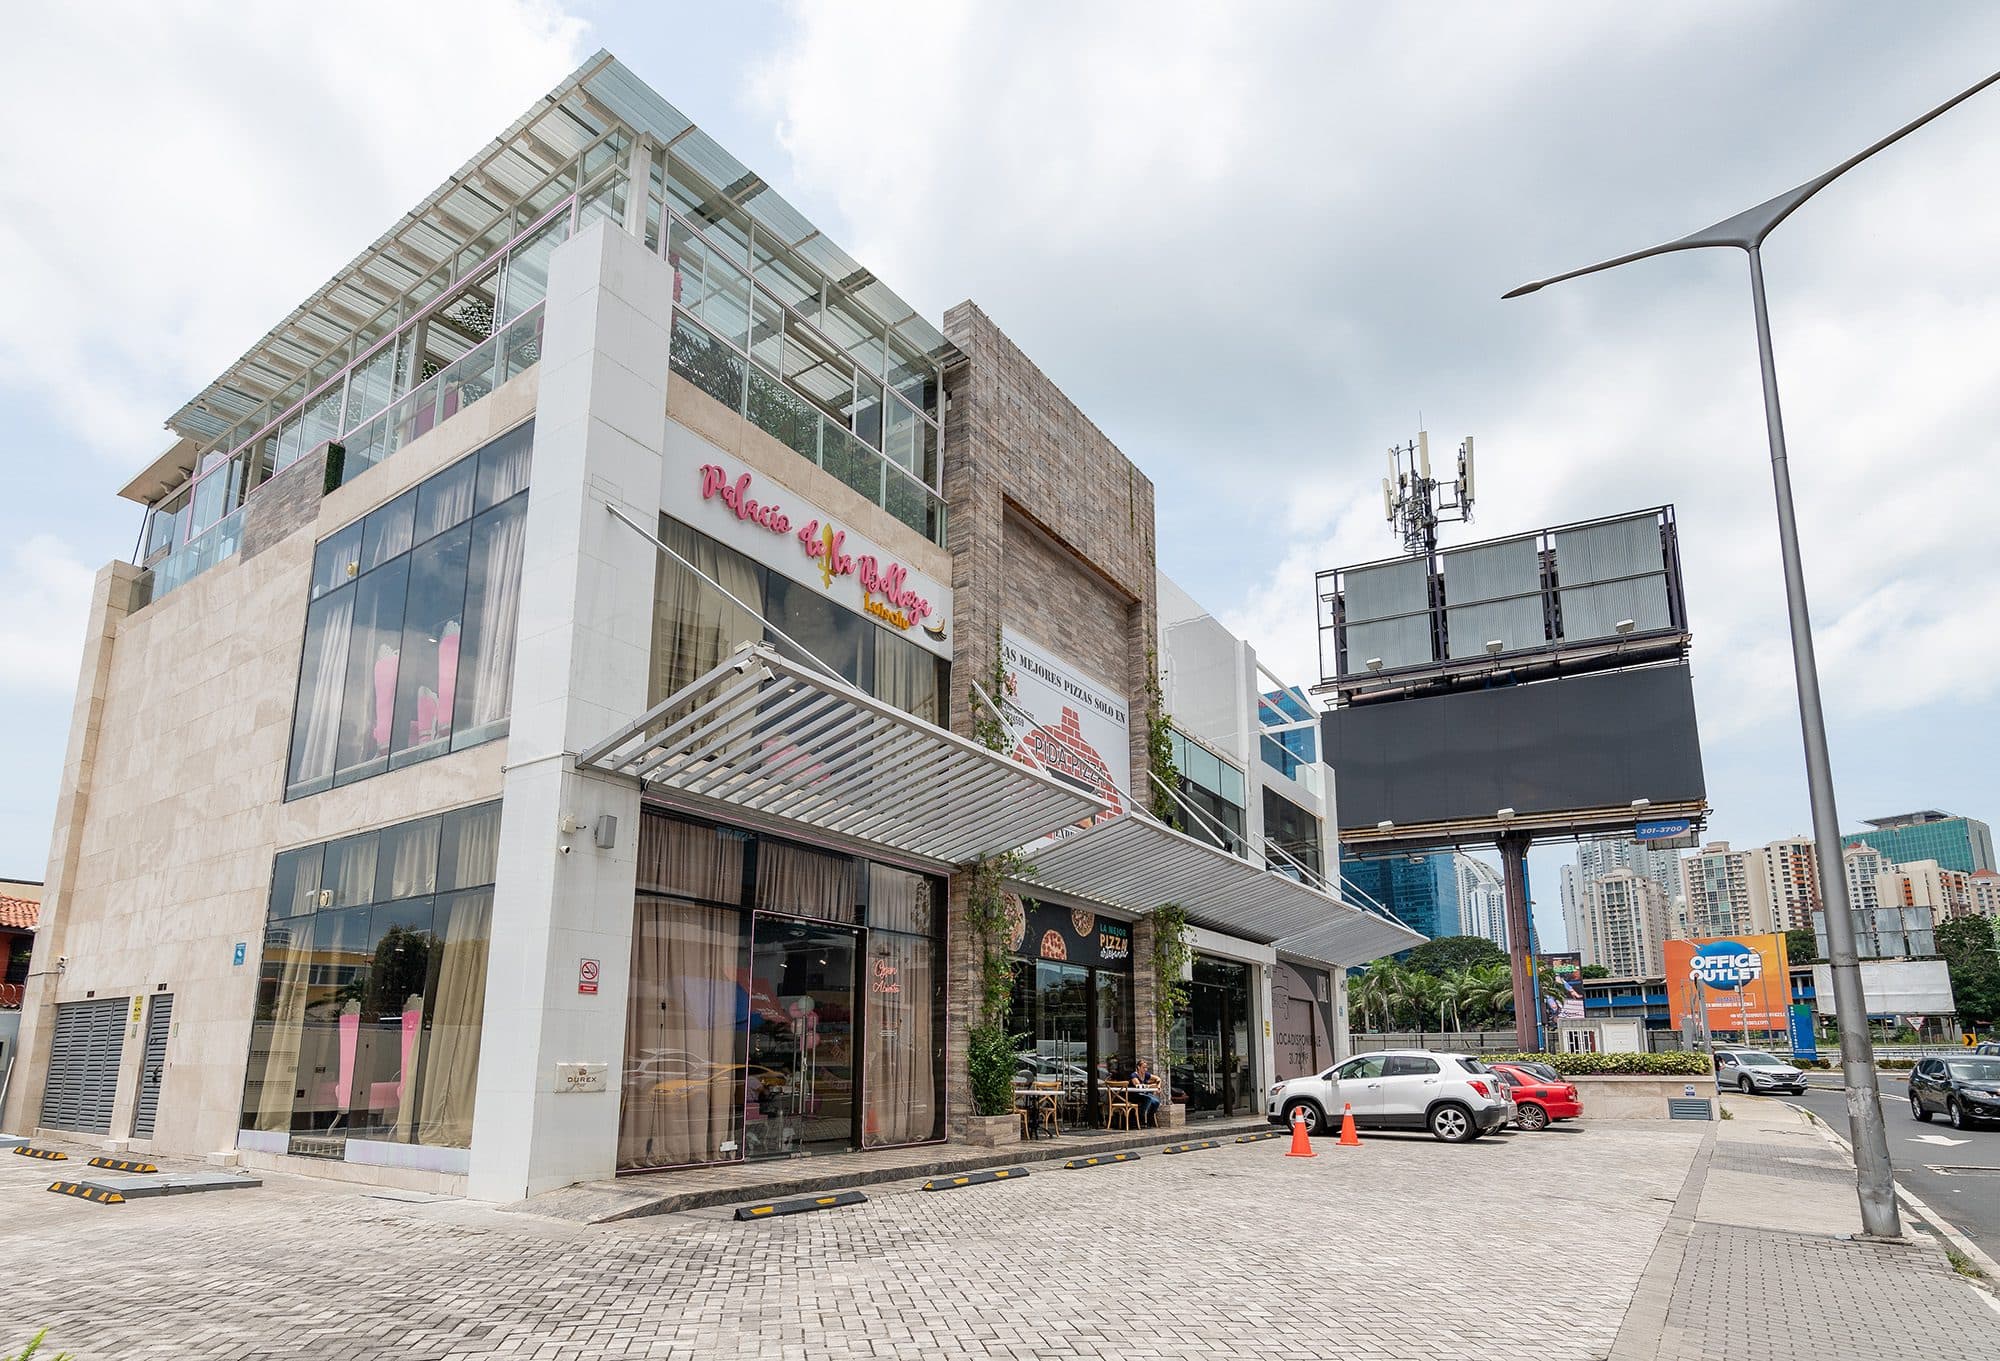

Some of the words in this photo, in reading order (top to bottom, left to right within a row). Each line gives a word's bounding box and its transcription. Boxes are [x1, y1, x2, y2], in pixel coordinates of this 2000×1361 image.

[699, 463, 793, 535] Palacio
[797, 519, 827, 559] de
[857, 554, 933, 627] Belleza
[1019, 654, 1062, 688] MEJORES
[1064, 679, 1093, 706] PIZZAS
[1094, 697, 1114, 718] SOLO
[1115, 709, 1126, 724] EN
[1034, 736, 1067, 767] PIDA
[1640, 826, 1682, 834] 301-3700
[872, 959, 897, 980] Open
[1689, 953, 1762, 970] OFFICE
[1689, 967, 1762, 982] OUTLET
[566, 1076, 598, 1084] DUREX
